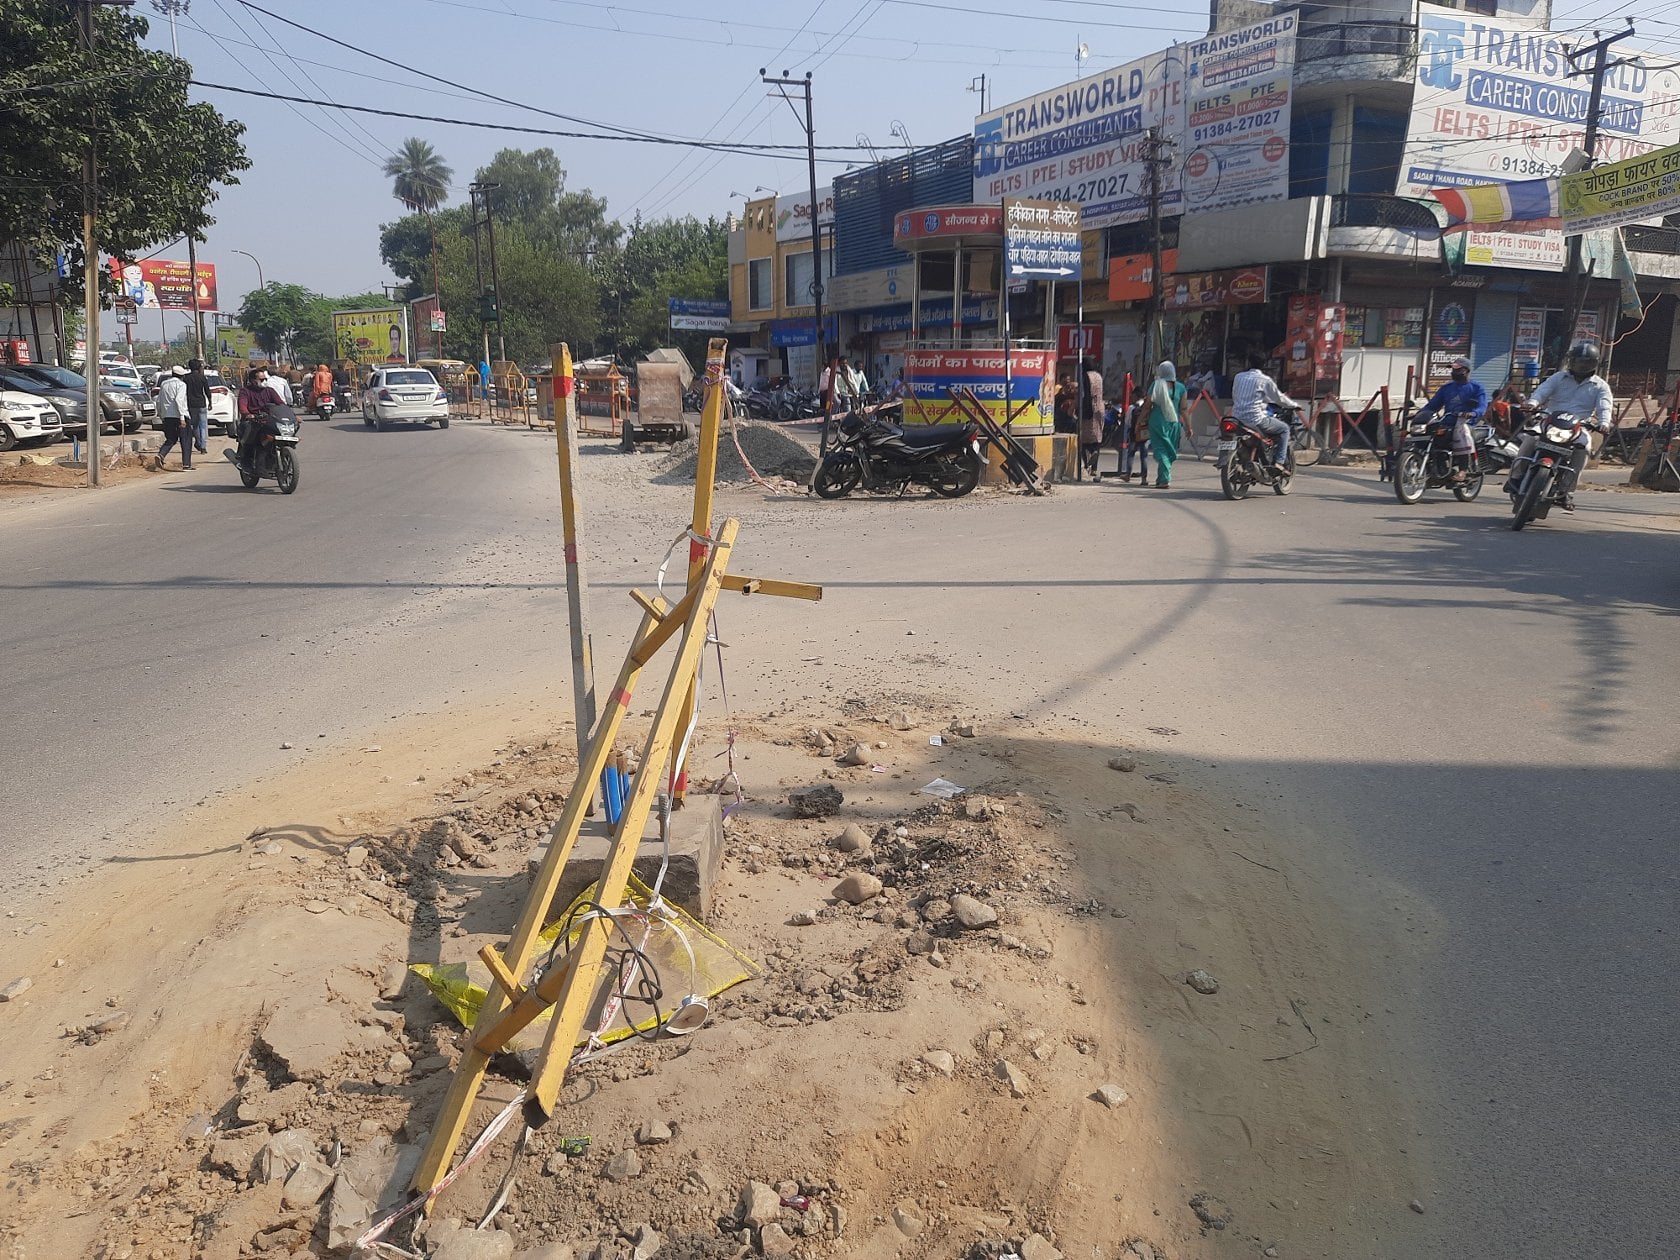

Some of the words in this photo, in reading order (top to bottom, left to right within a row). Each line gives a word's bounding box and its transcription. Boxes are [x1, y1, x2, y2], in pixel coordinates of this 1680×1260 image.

[1190, 16, 1294, 58] TRANSWORLD
[1471, 24, 1647, 94] TRANSWORLD
[1005, 68, 1143, 138] TRANSWORLD
[1148, 80, 1180, 112] PTE
[1194, 94, 1231, 113] IELTS
[1250, 82, 1275, 98] PTE
[1470, 74, 1532, 110] CAREER
[1536, 87, 1639, 130] CONSUTANTS
[1650, 90, 1677, 115] PTE
[1005, 138, 1047, 167] CAREER
[1050, 109, 1139, 152] CONSULTANTS
[1194, 110, 1280, 141] 91384-27027
[1434, 107, 1490, 139] IELTS
[1507, 119, 1545, 148] PTE
[1557, 129, 1616, 159] STDY
[989, 174, 1022, 197] IELTS
[1032, 164, 1057, 185] PTE
[1068, 150, 1114, 176] STUDY
[1120, 142, 1146, 162] VIS
[1413, 172, 1434, 181] SADAR
[1435, 175, 1455, 184] THANA
[1456, 177, 1474, 187] ROAD,
[1584, 169, 1620, 192] चोपड़ा
[1624, 158, 1657, 181] फायर
[1027, 173, 1129, 202] 1384-27027
[1599, 191, 1620, 202] COCK
[1621, 183, 1649, 197] BRAND
[1661, 172, 1680, 185] 50%
[1657, 185, 1676, 197] 80%
[793, 201, 824, 219] Sagr
[945, 213, 977, 226] सौजन्य
[980, 213, 989, 224] से
[1036, 208, 1049, 225] नगर
[1008, 248, 1019, 263] चार
[1470, 234, 1491, 245] IELTS
[1498, 237, 1512, 247] PTE
[1518, 239, 1542, 250] STUDY
[1544, 241, 1560, 252] VISA
[945, 358, 967, 369] का
